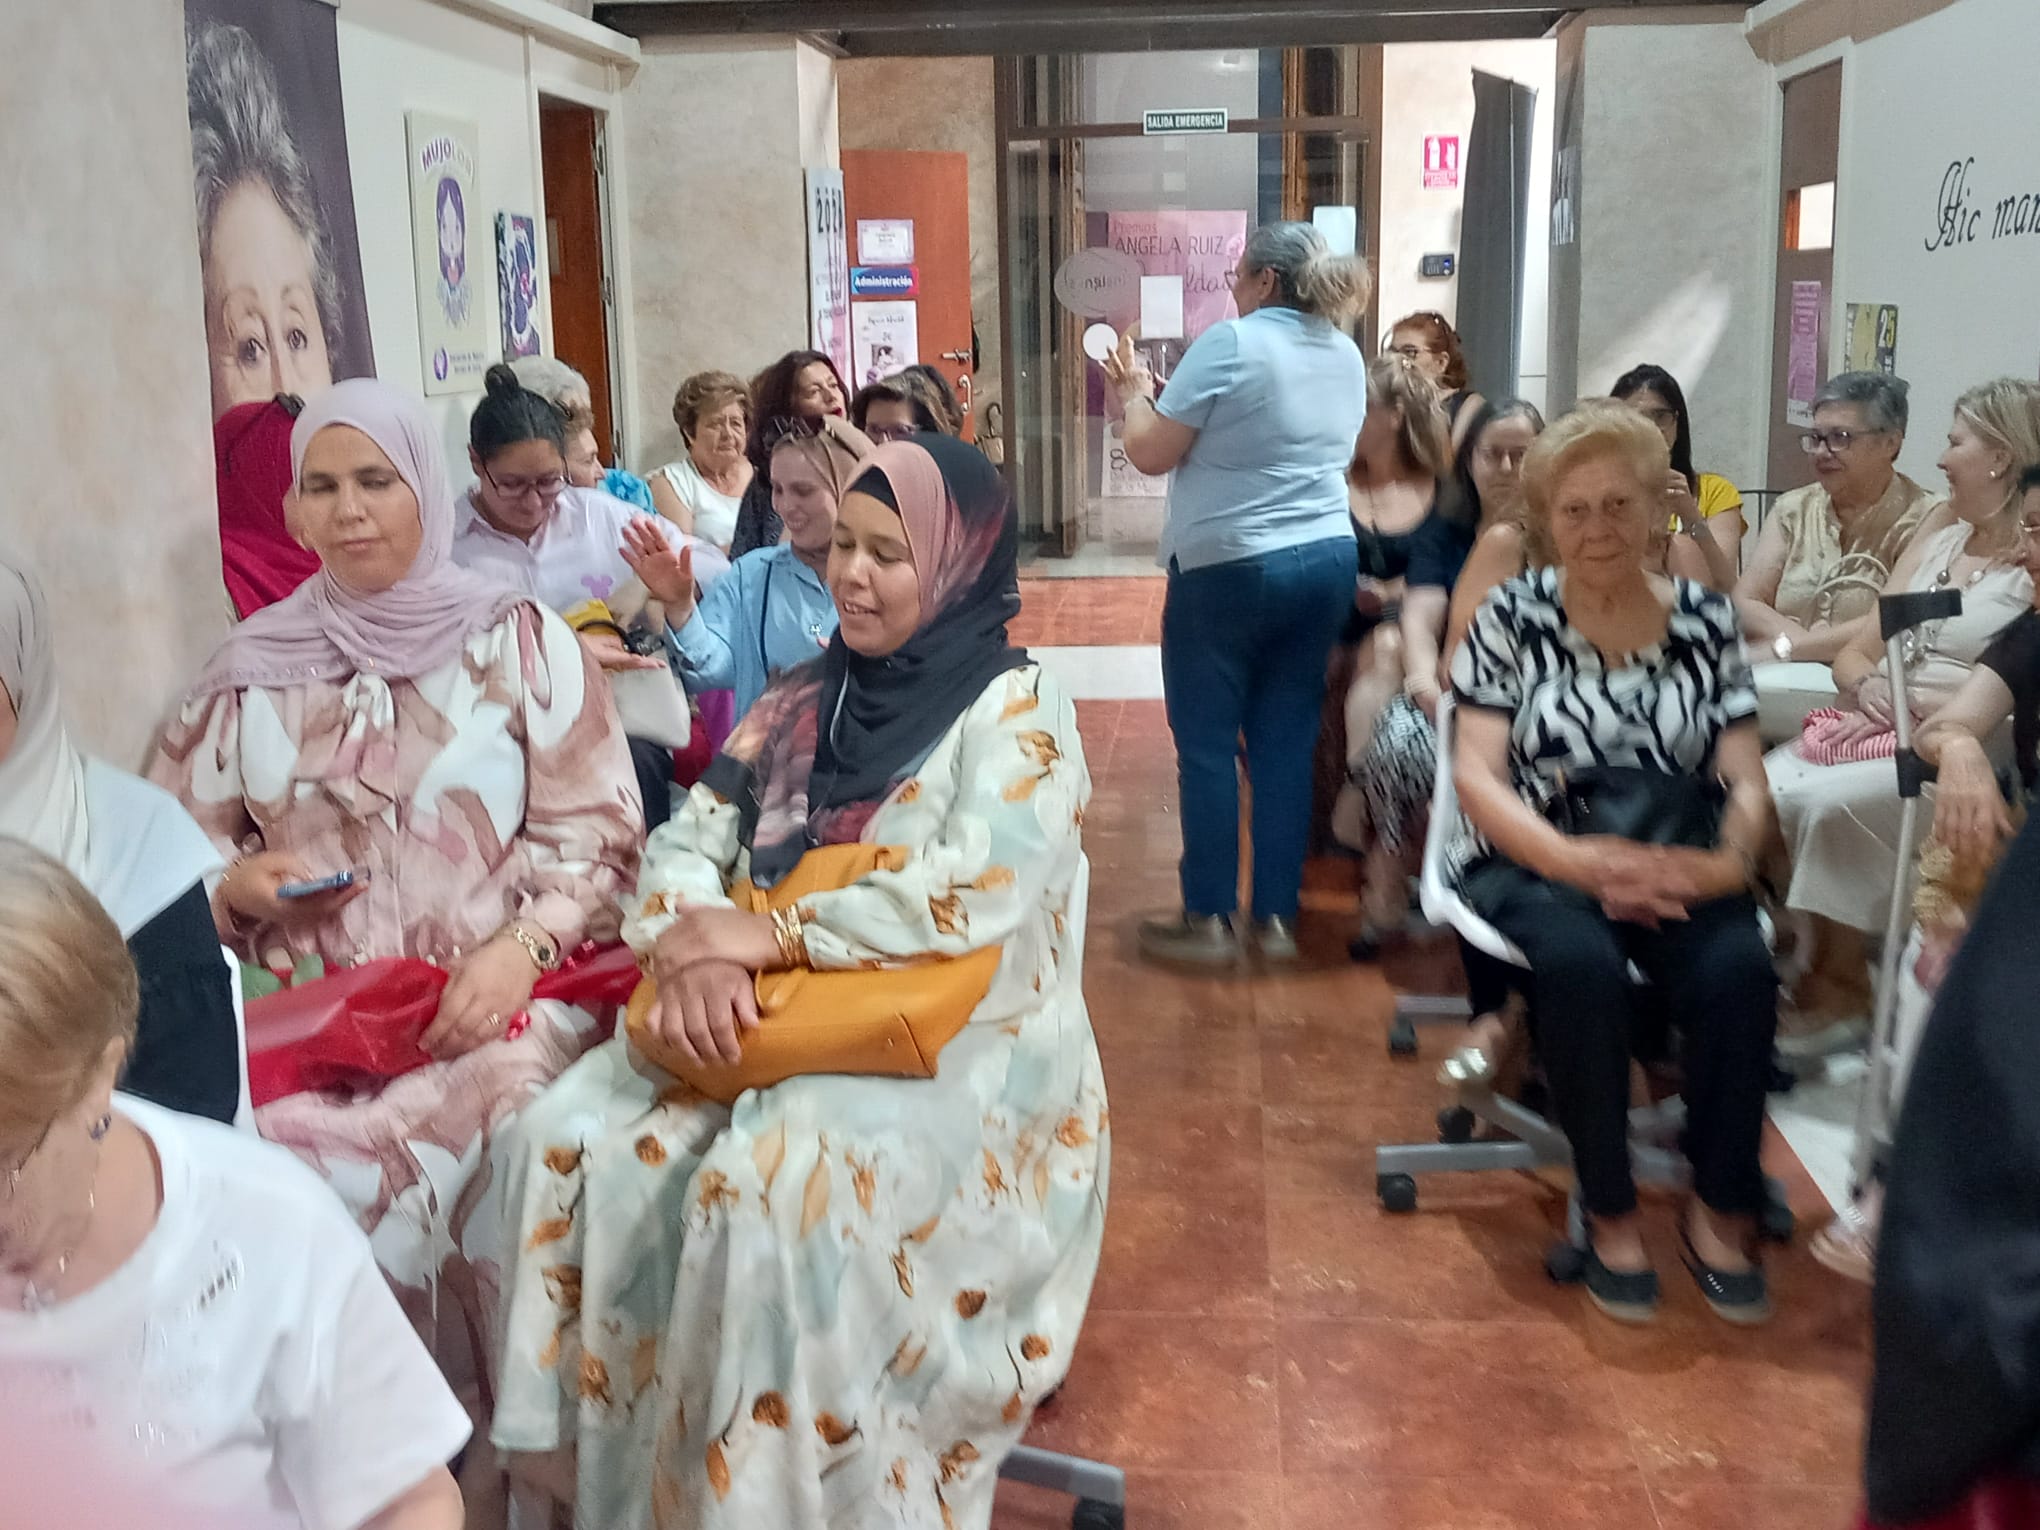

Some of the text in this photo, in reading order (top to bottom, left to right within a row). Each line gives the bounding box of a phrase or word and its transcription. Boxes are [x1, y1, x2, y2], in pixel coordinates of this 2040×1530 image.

[1147, 113, 1224, 128] SALIDA EMERGENCIA
[1113, 220, 1158, 233] Premios
[1116, 234, 1224, 256] ANGELA RUIZ
[854, 275, 913, 288] Administración
[1878, 308, 1896, 348] 25
